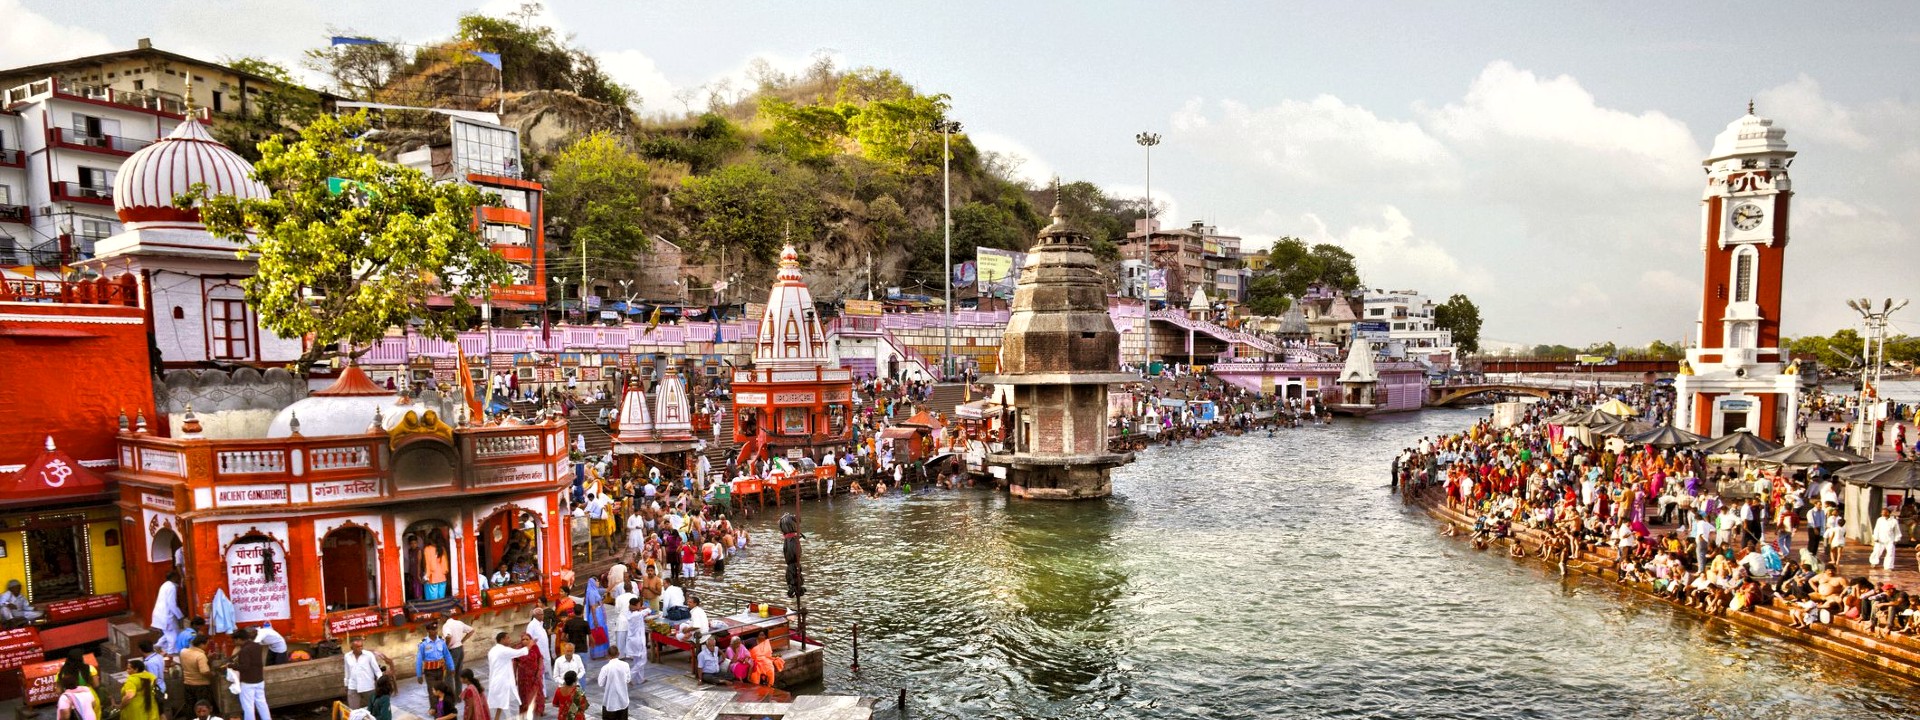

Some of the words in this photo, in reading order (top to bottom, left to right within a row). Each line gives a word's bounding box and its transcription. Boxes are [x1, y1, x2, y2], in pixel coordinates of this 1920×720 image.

[219, 490, 246, 502] ANCIENT
[315, 482, 339, 496] गंगा
[231, 562, 252, 576] गंगा
